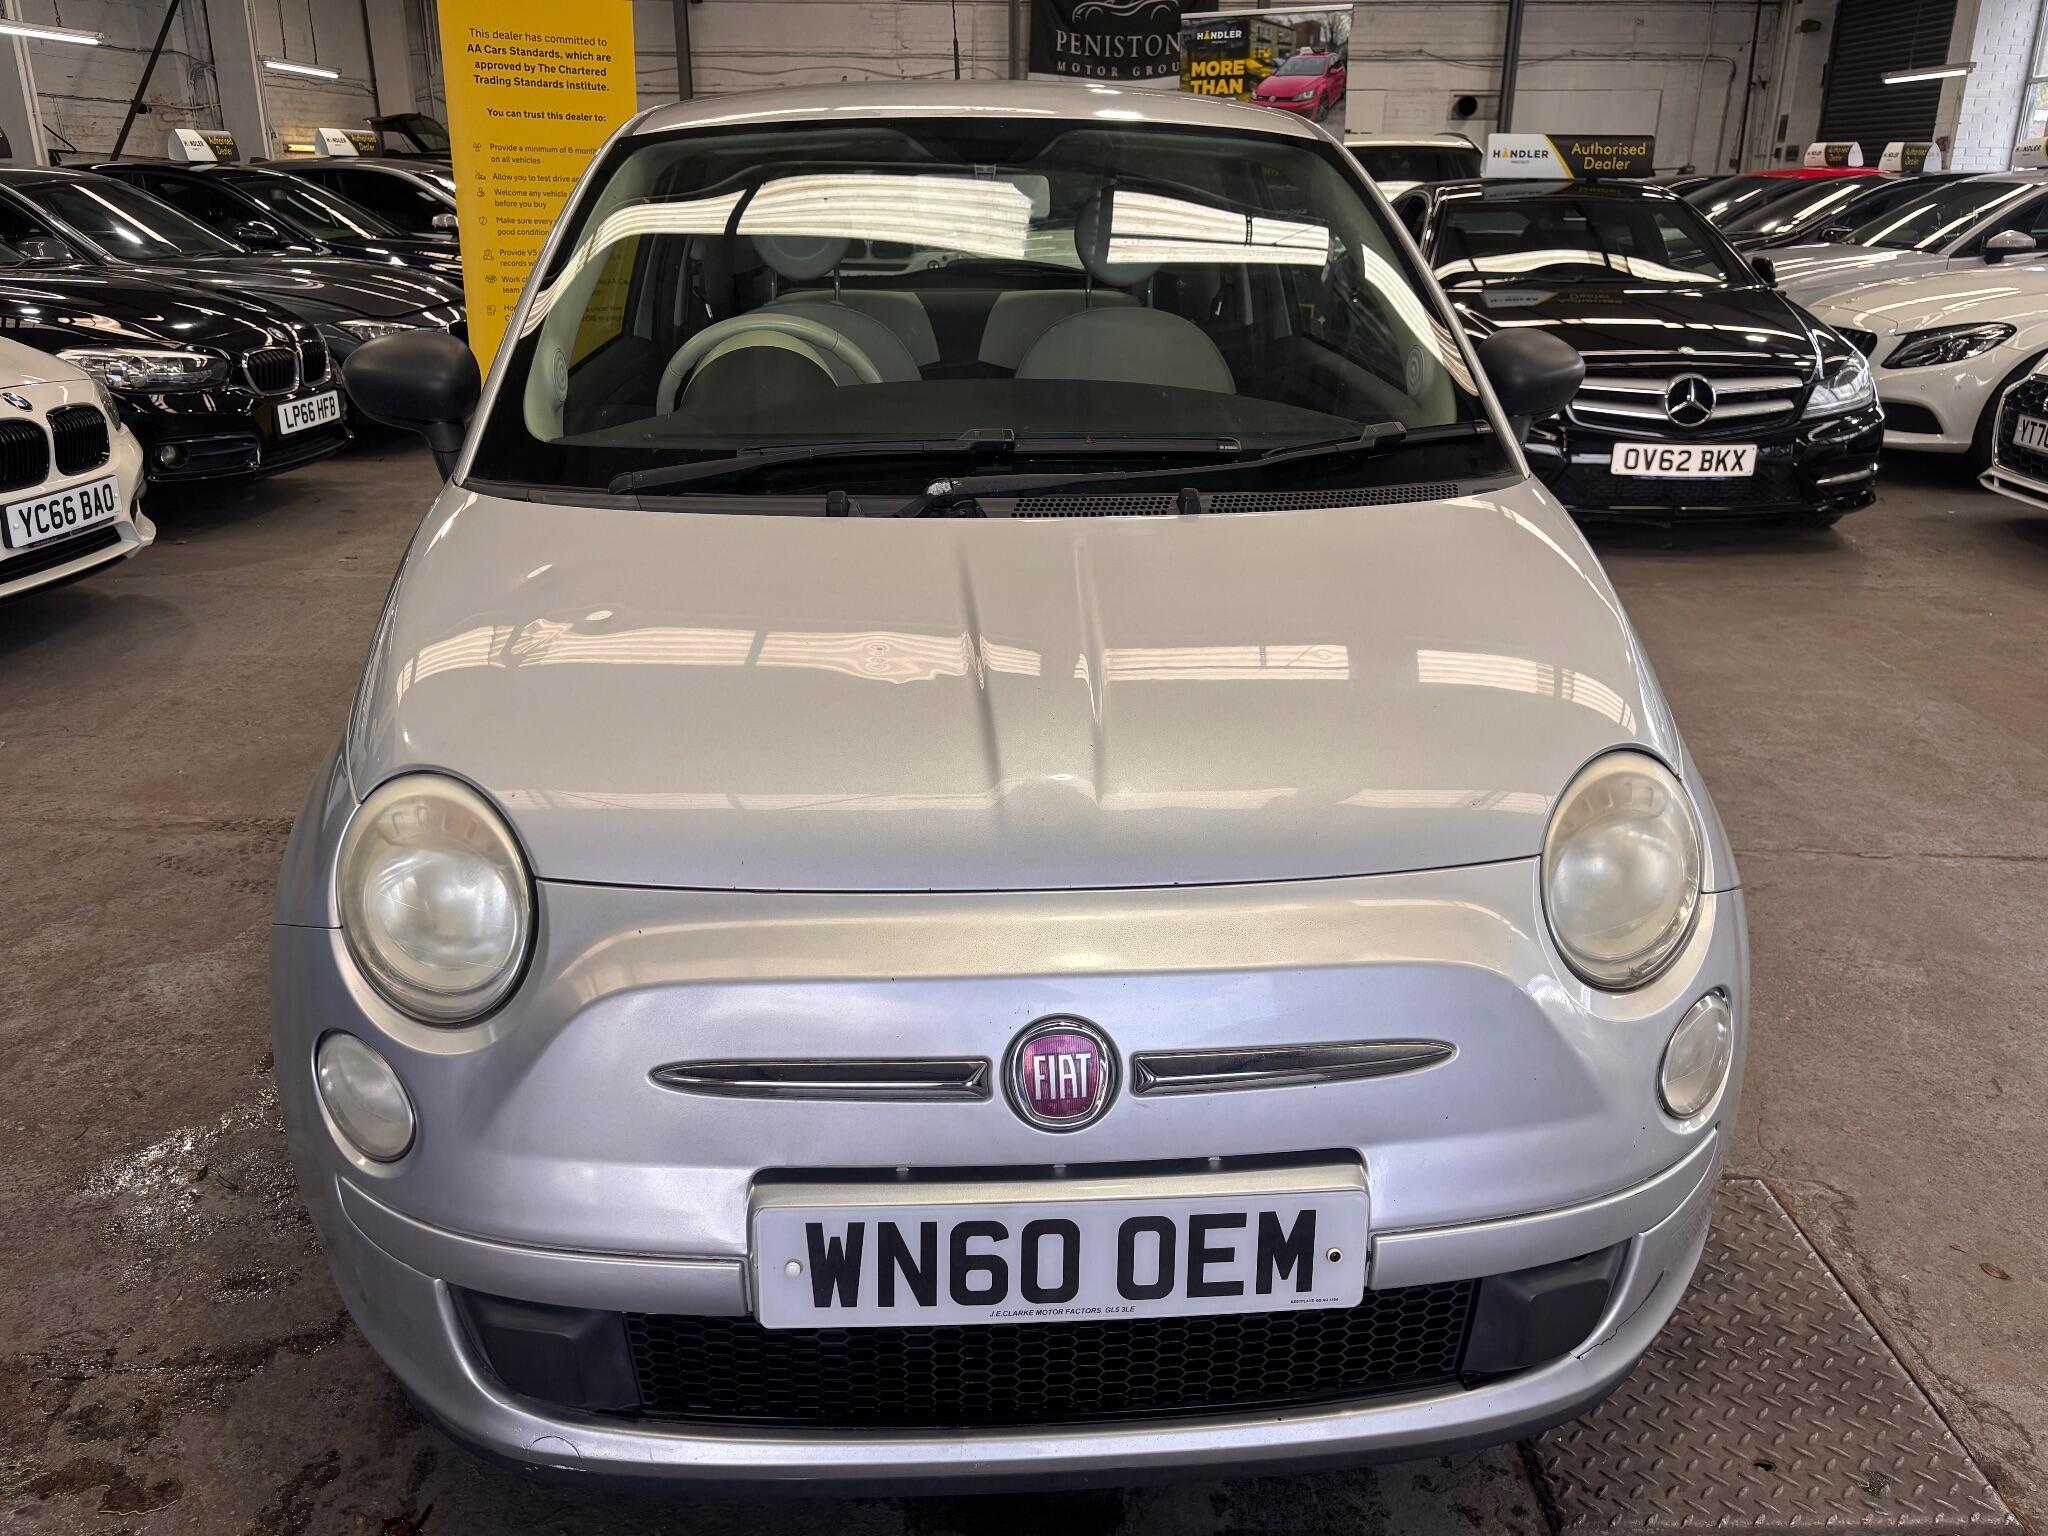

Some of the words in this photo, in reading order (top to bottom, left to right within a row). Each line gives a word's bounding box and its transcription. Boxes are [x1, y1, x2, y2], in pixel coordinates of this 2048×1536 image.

[469, 27, 490, 39] This
[492, 30, 523, 41] dealer
[525, 32, 542, 43] has
[544, 35, 596, 47] committed
[598, 38, 608, 47] to
[467, 43, 482, 54] AA
[484, 44, 507, 55] Cars
[509, 46, 563, 60] Standards,
[565, 51, 594, 61] which
[596, 54, 612, 62] are
[474, 61, 522, 71] approved
[524, 63, 536, 74] by
[537, 63, 557, 74] The
[558, 65, 607, 77] Chartered
[1057, 61, 1119, 77] MOTOR
[1191, 60, 1246, 77] MORE
[473, 74, 512, 88] Trading
[514, 77, 564, 89] Standards
[566, 80, 610, 92] Institute.
[1190, 78, 1244, 95] THAN
[487, 108, 504, 117] You
[506, 110, 522, 118] can
[524, 110, 545, 119] trust
[547, 111, 564, 120] this
[565, 112, 593, 121] dealer
[595, 114, 607, 122] to:
[490, 143, 517, 152] Provide
[525, 145, 558, 153] minimum
[559, 146, 567, 154] of
[568, 146, 574, 154] 6
[1571, 142, 1647, 156] Authorised
[512, 156, 541, 165] vehicles
[1584, 157, 1631, 170] Dealer
[492, 173, 512, 181] Allow
[514, 174, 527, 182] you
[528, 174, 536, 182] to
[537, 174, 551, 182] test
[552, 175, 571, 183] drive
[494, 188, 527, 197] Welcome
[529, 191, 541, 199] any
[495, 199, 518, 208] before
[519, 201, 532, 209] you
[534, 201, 547, 209] buy
[496, 216, 516, 225] Make
[497, 228, 515, 237] good
[500, 248, 526, 257] Provide
[501, 275, 520, 283] Work
[283, 401, 316, 430] LP66
[316, 396, 336, 420] HFB
[1624, 448, 1692, 472] OV62
[1698, 448, 1747, 472] BKX
[18, 495, 77, 538] YC66
[79, 483, 115, 521] BAO
[1033, 1052, 1091, 1100] FIAT
[805, 1218, 1082, 1309] WN60
[1116, 1208, 1317, 1301] OEM
[1036, 1308, 1064, 1317] MOTOR
[1065, 1307, 1102, 1315] FACTORS
